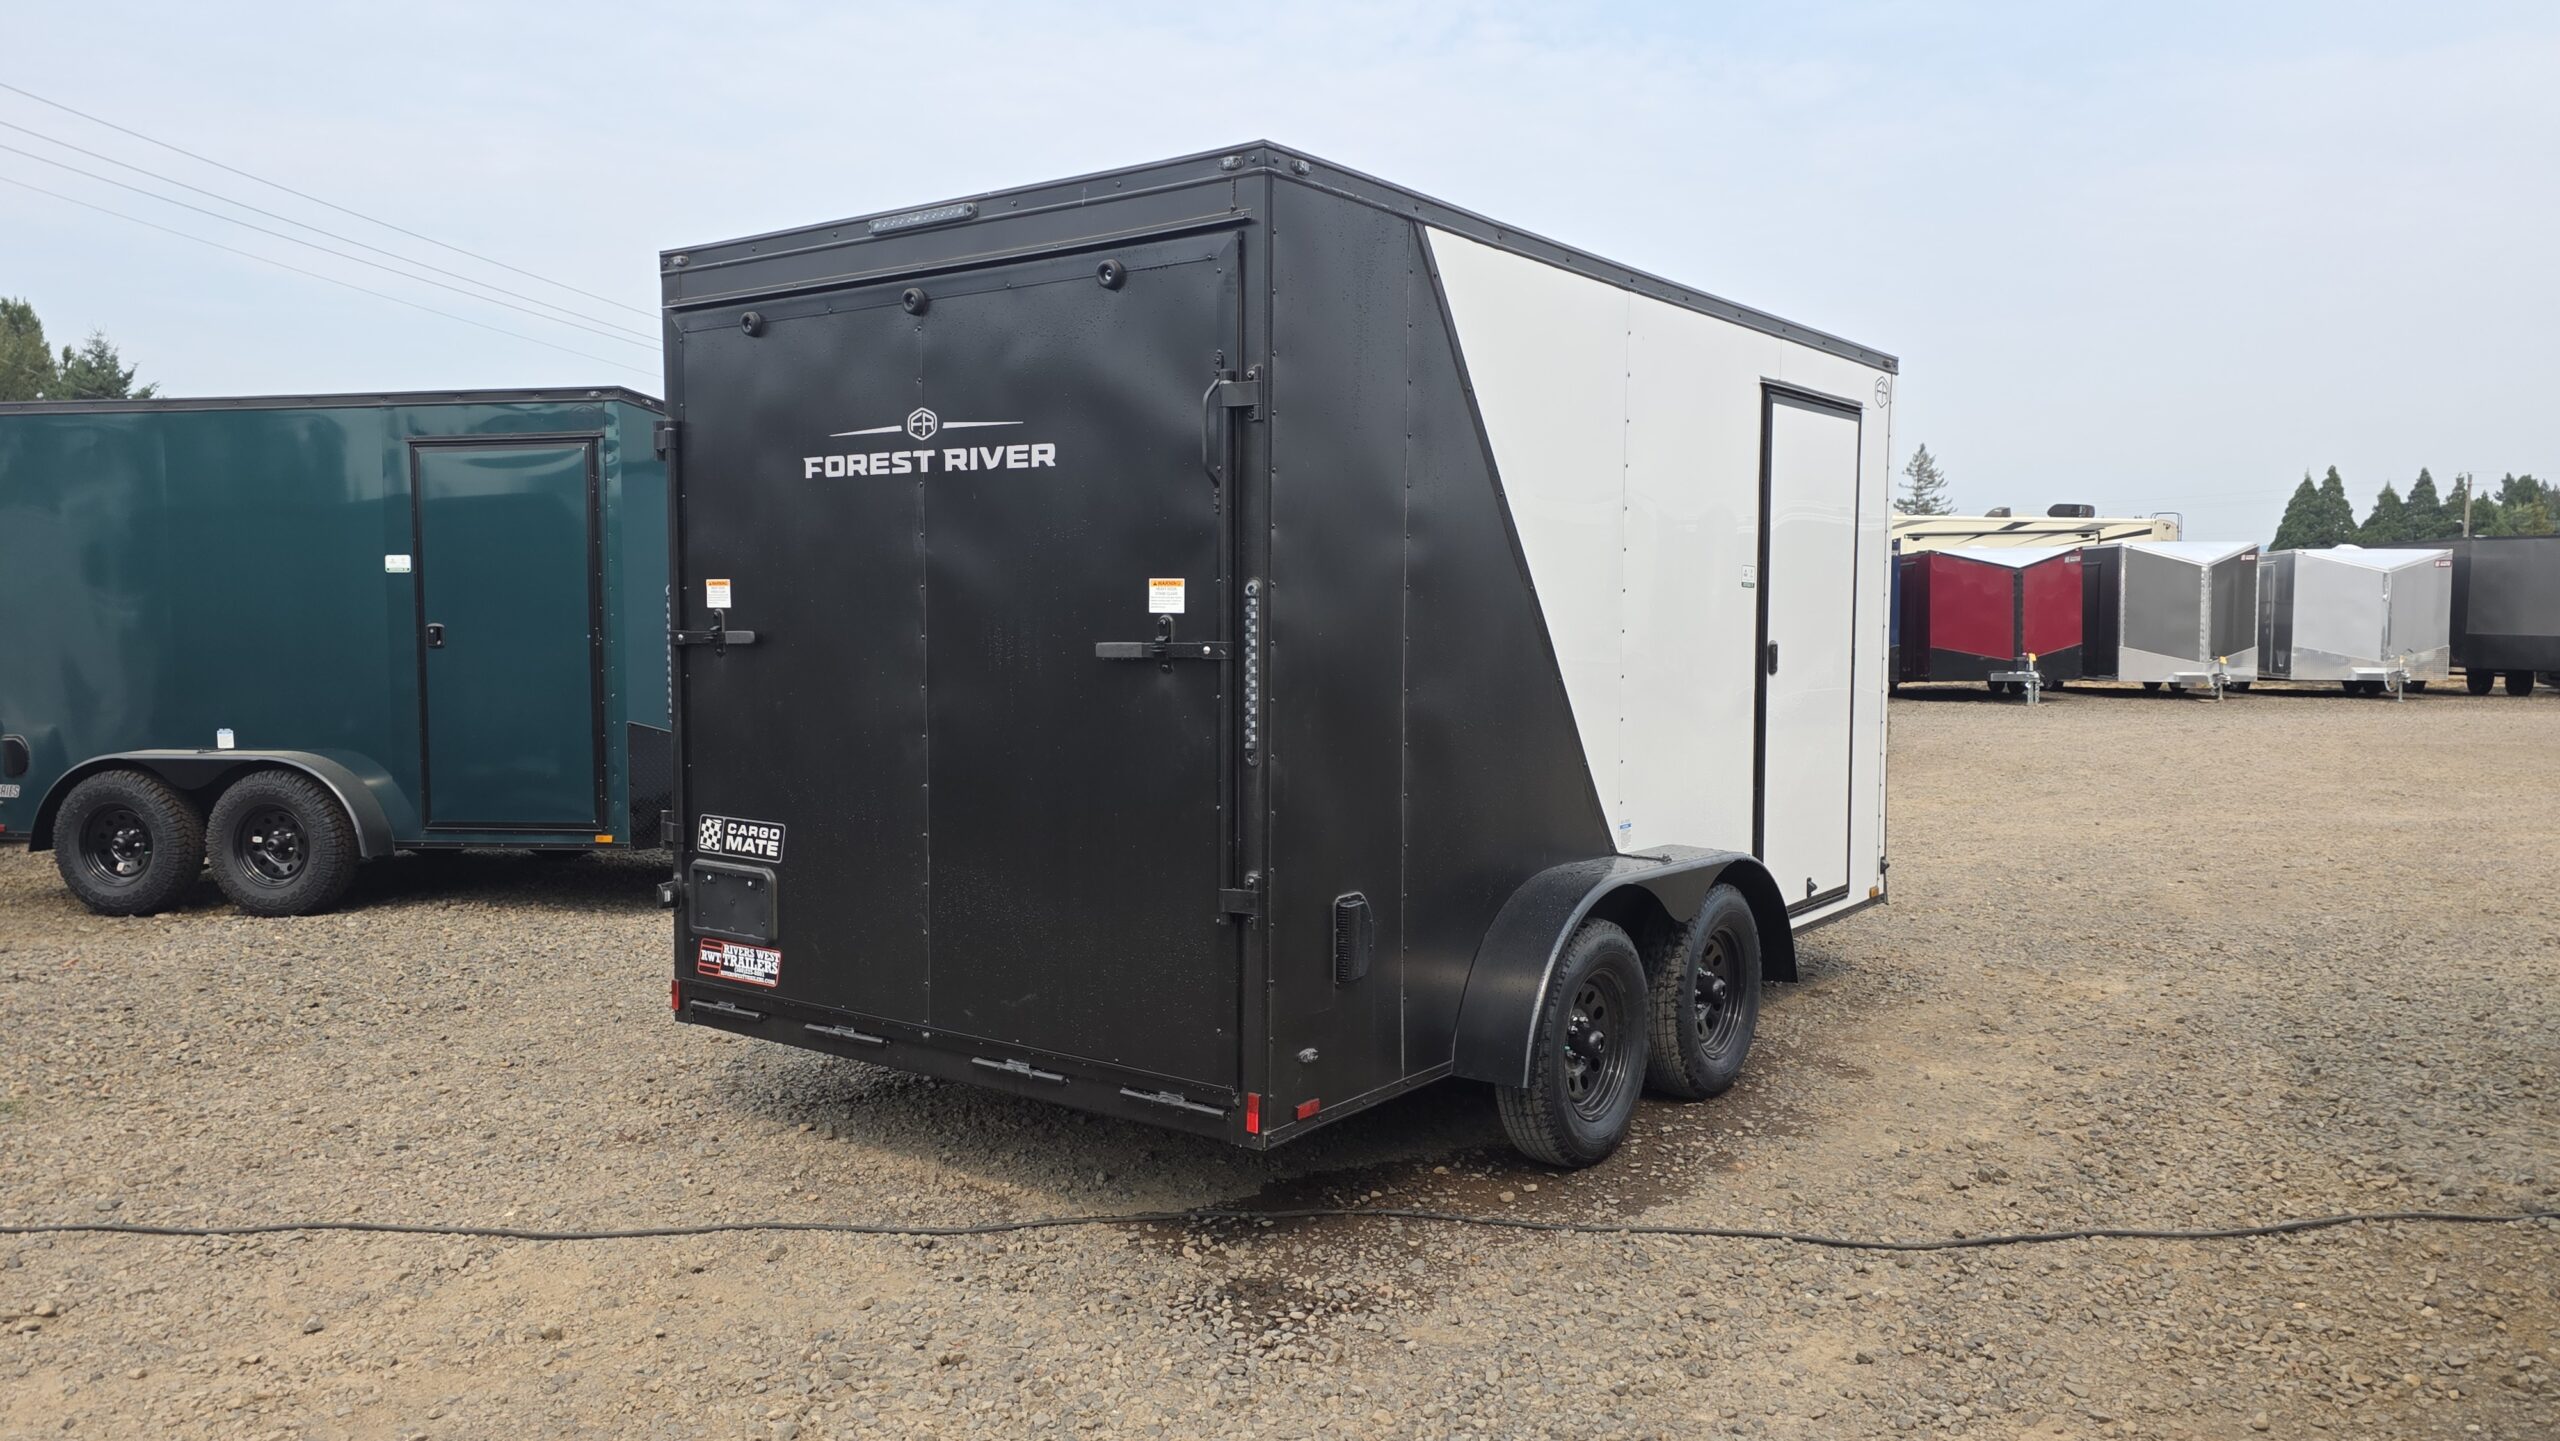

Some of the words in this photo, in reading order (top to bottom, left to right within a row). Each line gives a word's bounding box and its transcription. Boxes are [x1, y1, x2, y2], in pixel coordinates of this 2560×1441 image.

[803, 449, 935, 479] FOREST
[942, 443, 1056, 473] RIVER
[0, 785, 19, 796] RIES
[727, 822, 780, 840] CARGO
[725, 836, 779, 857] MATE
[701, 950, 721, 963] RWT
[723, 944, 755, 958] RIVERS
[755, 950, 780, 962] WEST
[723, 953, 778, 974] TRAILERS
